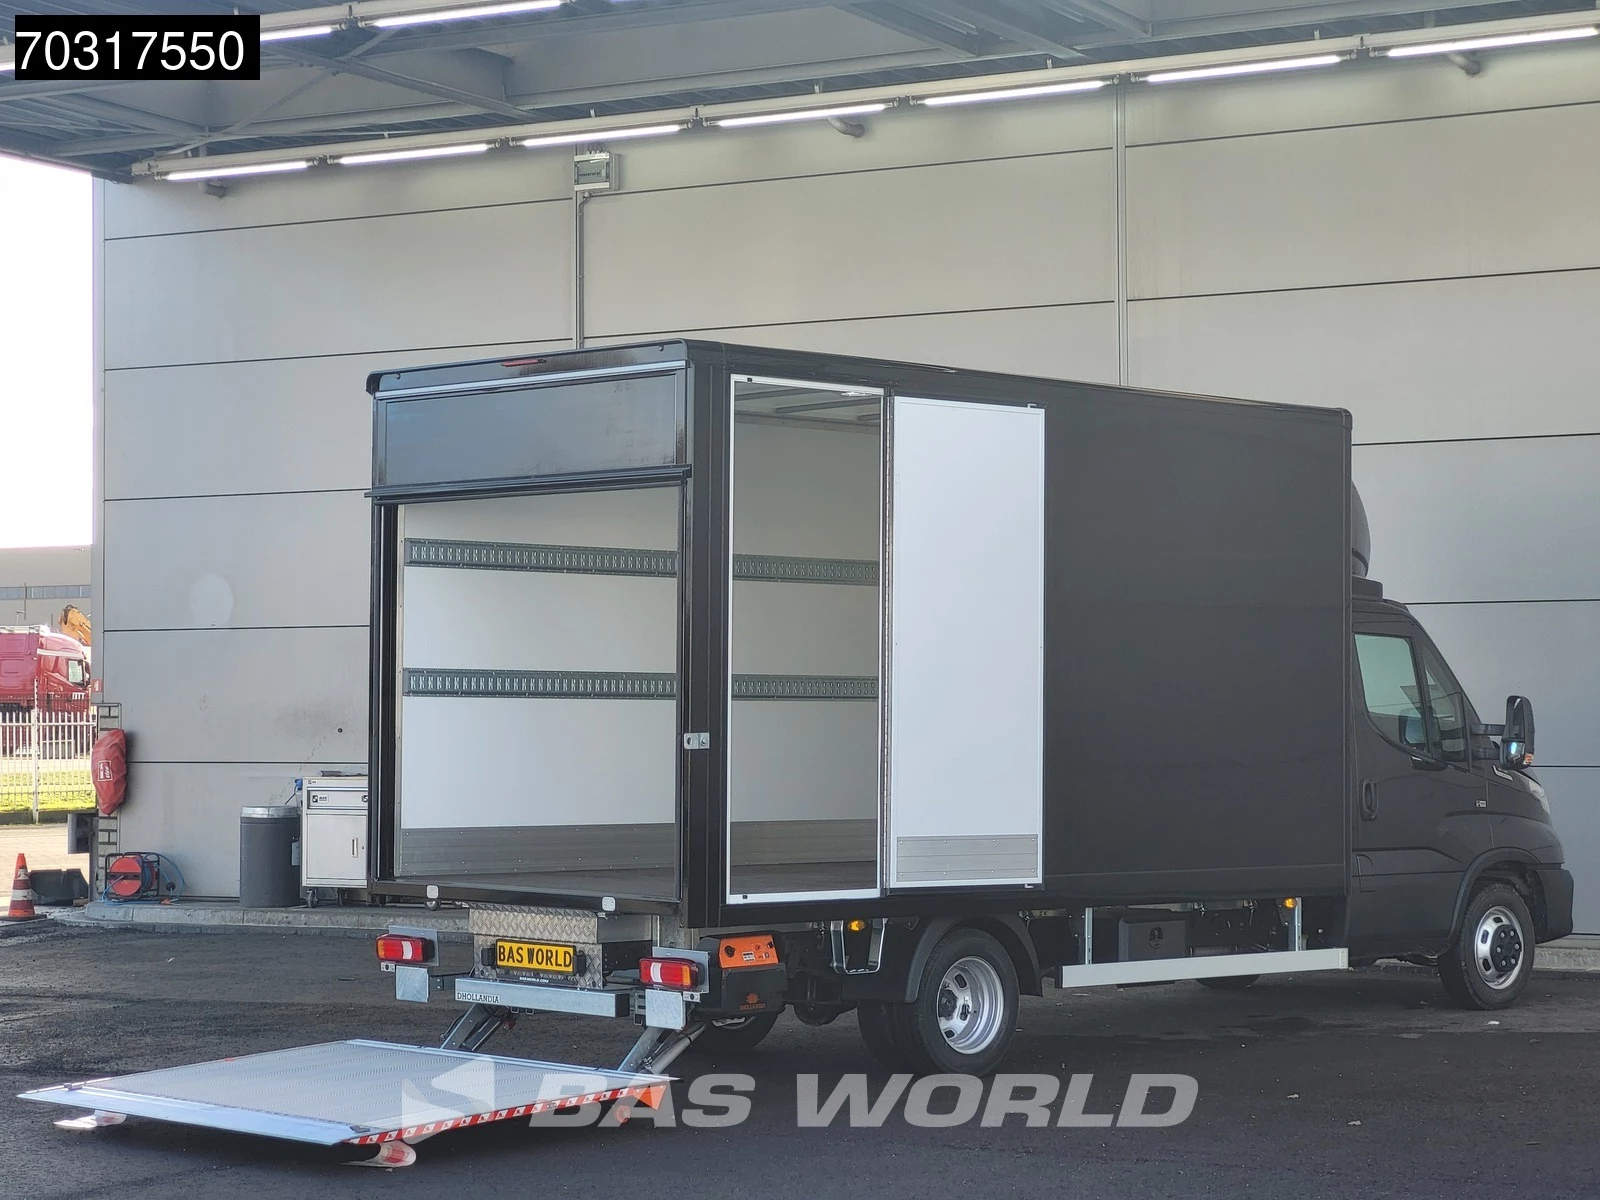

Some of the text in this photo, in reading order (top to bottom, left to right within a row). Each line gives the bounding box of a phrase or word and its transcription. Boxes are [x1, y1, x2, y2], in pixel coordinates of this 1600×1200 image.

[498, 945, 572, 968] BAS WORLD
[457, 992, 499, 1004] DHOLLANDIA
